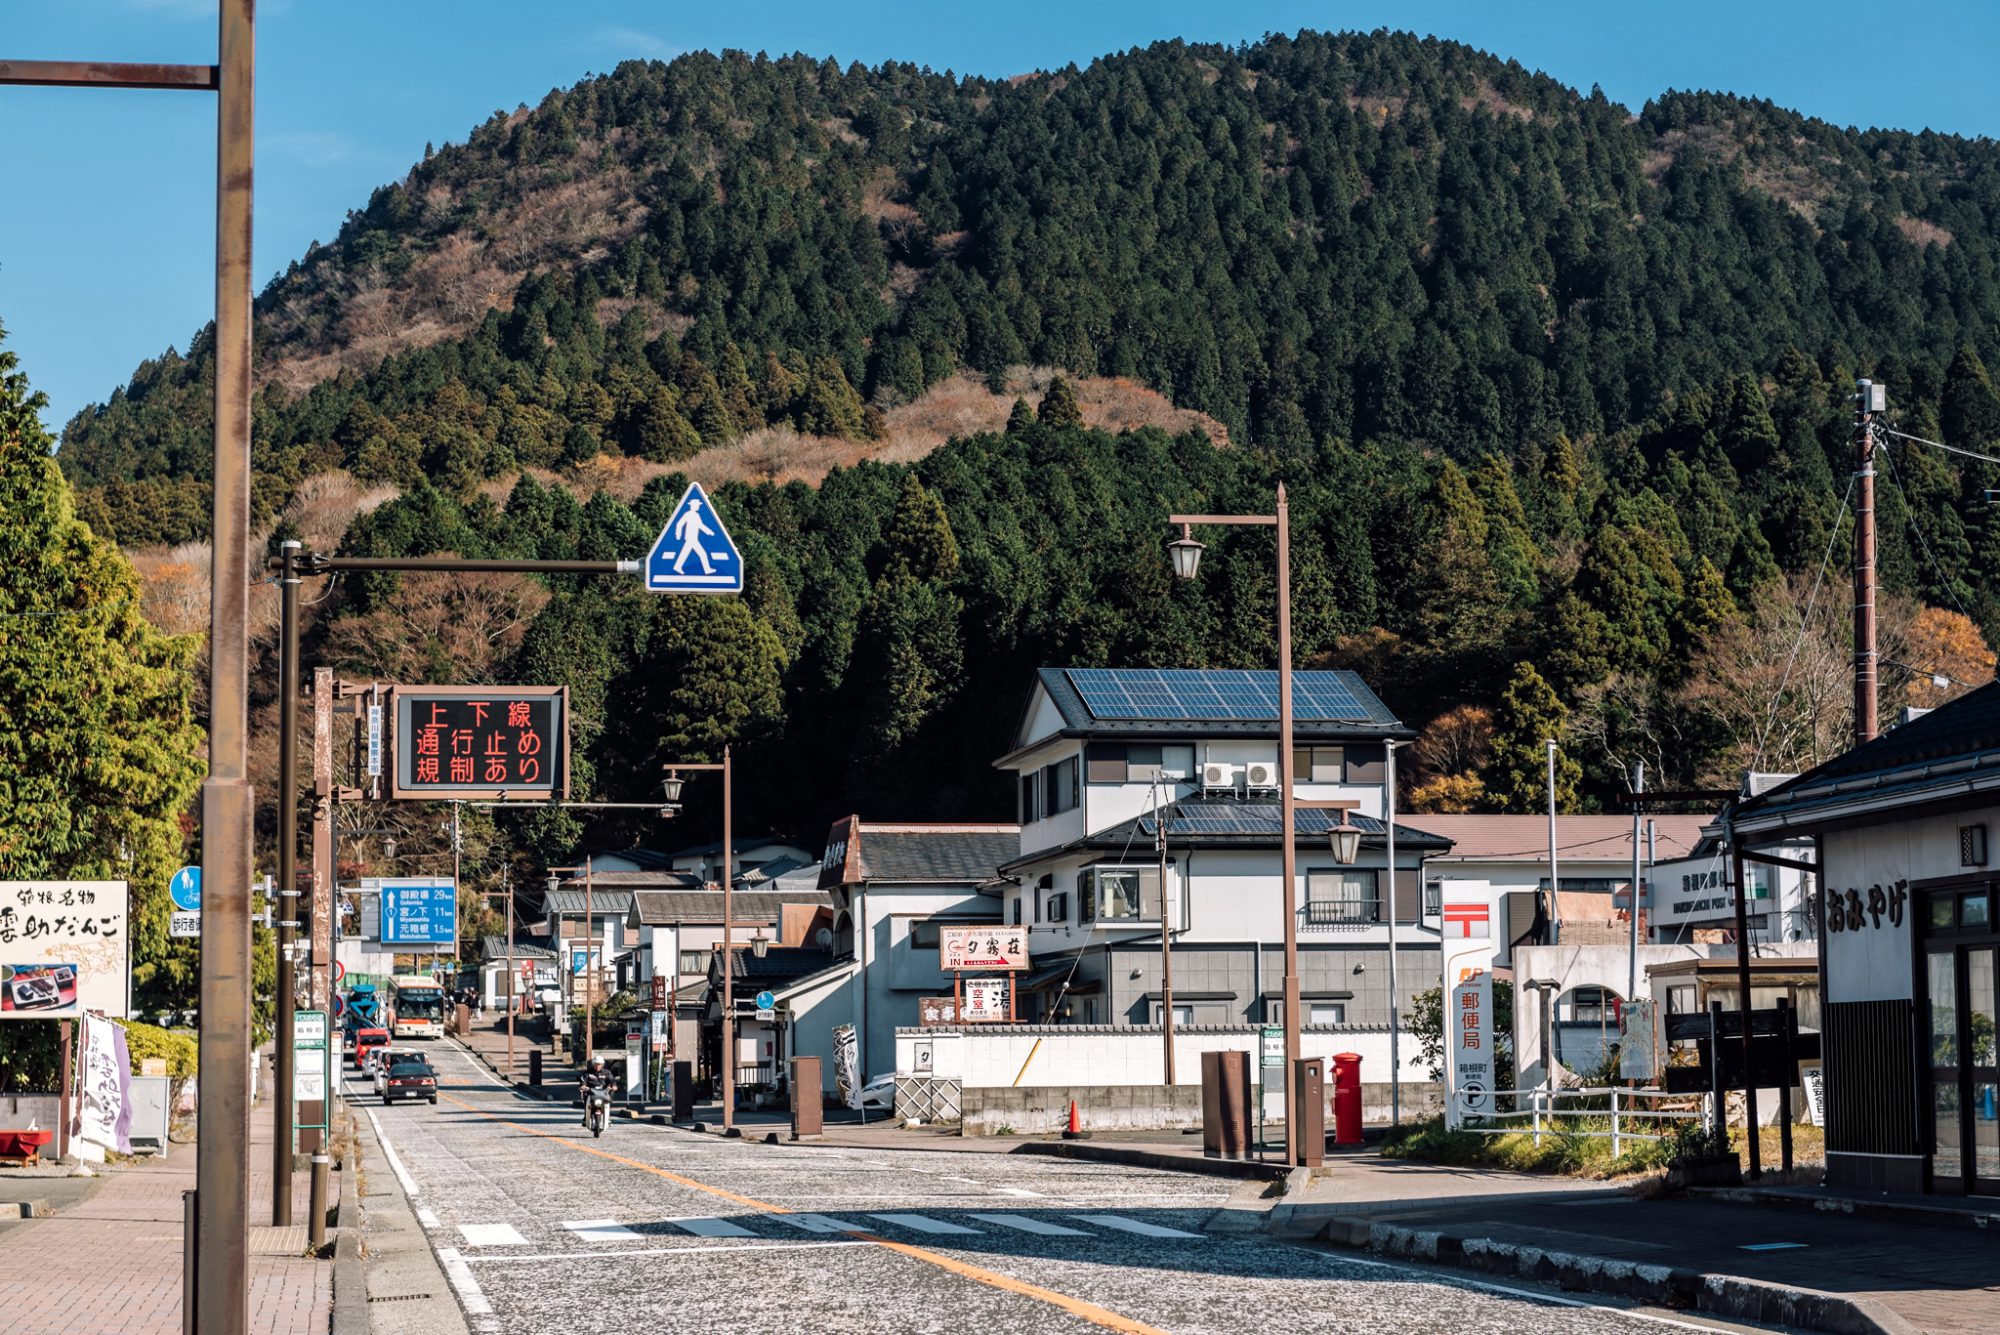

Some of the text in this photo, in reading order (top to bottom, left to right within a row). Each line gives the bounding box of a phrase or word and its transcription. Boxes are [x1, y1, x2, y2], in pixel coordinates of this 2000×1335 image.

[371, 708, 379, 773] 神奈川県警察本部
[416, 728, 541, 755] 通行止め
[416, 757, 540, 783] 規制あり
[17, 888, 96, 907] 箱根名物
[1711, 897, 1726, 910] POST
[1827, 879, 1908, 933] おみやげ
[400, 907, 428, 917] 宮ノ下
[400, 924, 429, 934] 元箱根
[968, 938, 1020, 956] 夕霧荘
[1461, 992, 1480, 1050] 郵便局
[1459, 1064, 1487, 1073] 箱根町
